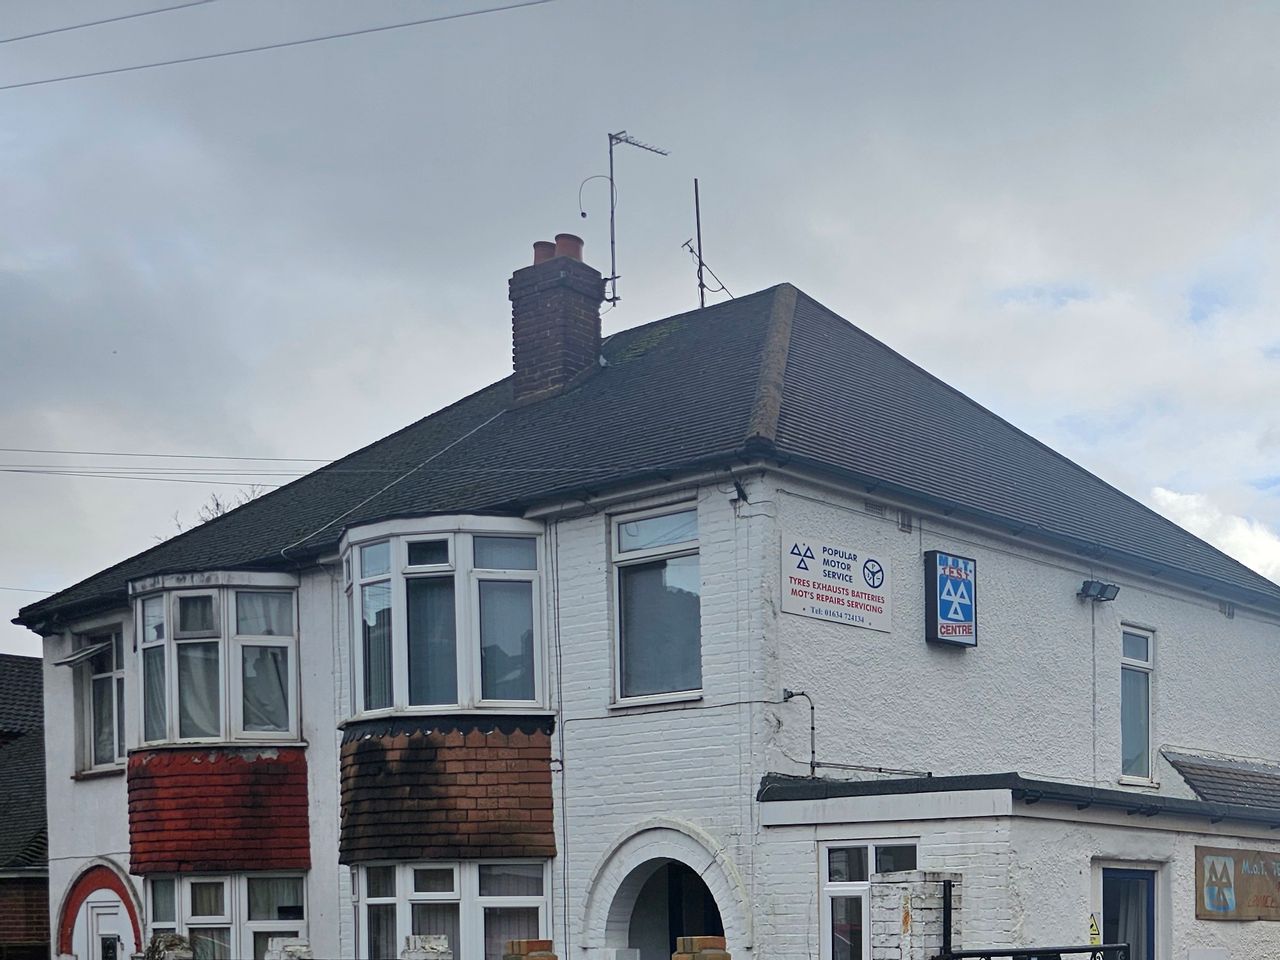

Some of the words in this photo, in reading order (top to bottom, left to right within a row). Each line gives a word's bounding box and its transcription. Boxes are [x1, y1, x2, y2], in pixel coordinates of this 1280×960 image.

[822, 546, 858, 562] POPULAR
[822, 558, 851, 571] MOTOR
[822, 569, 853, 583] SERVICE
[942, 567, 969, 580] TEST
[789, 576, 810, 588] TYRES
[812, 581, 849, 596] EXHAUSTS
[851, 589, 885, 604] BATTERIES
[791, 588, 814, 600] MOT'S
[816, 593, 845, 606] REPAIRS
[847, 599, 883, 614] SERVICING
[811, 606, 823, 615] Tel:
[824, 609, 842, 619] 01634
[844, 612, 864, 623] 724134
[940, 624, 972, 635] CENTRE
